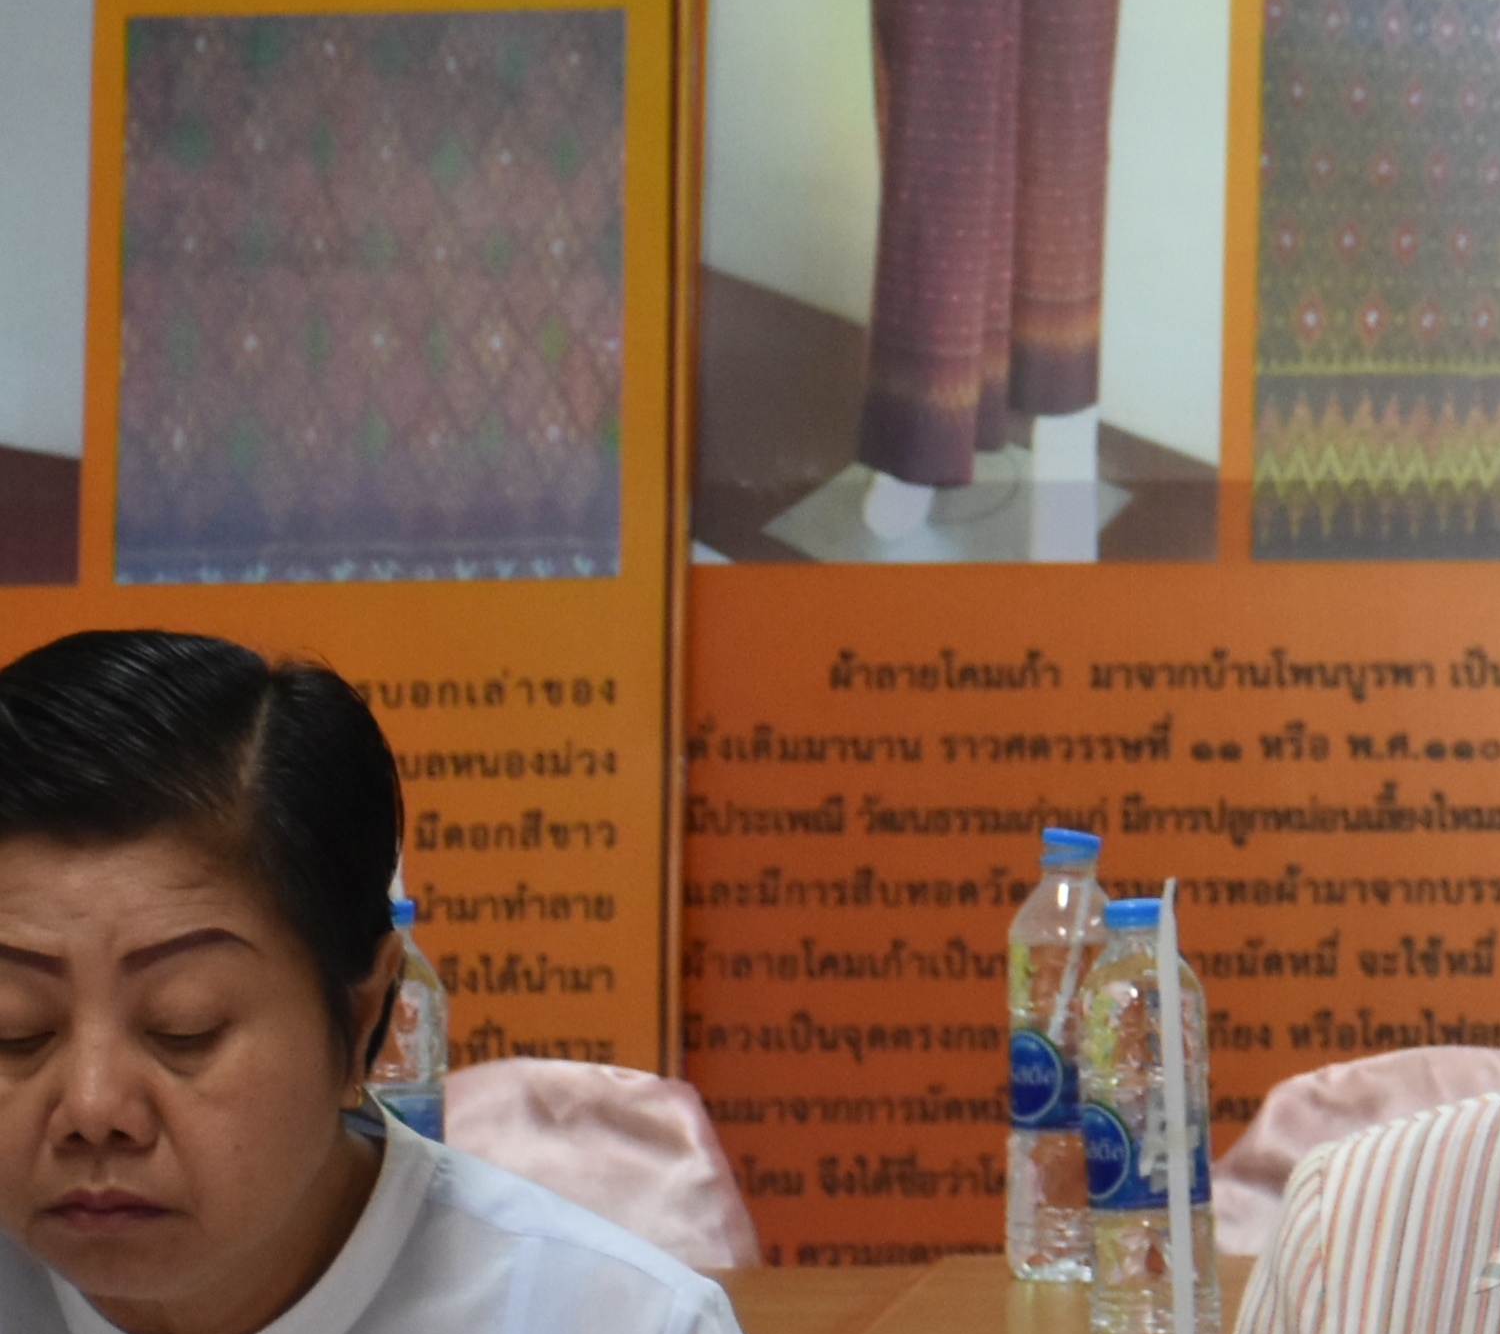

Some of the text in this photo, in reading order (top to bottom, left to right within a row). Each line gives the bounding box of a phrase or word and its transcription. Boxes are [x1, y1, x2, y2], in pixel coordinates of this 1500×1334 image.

[827, 647, 1061, 692] ผ้าลายโคมเก้า
